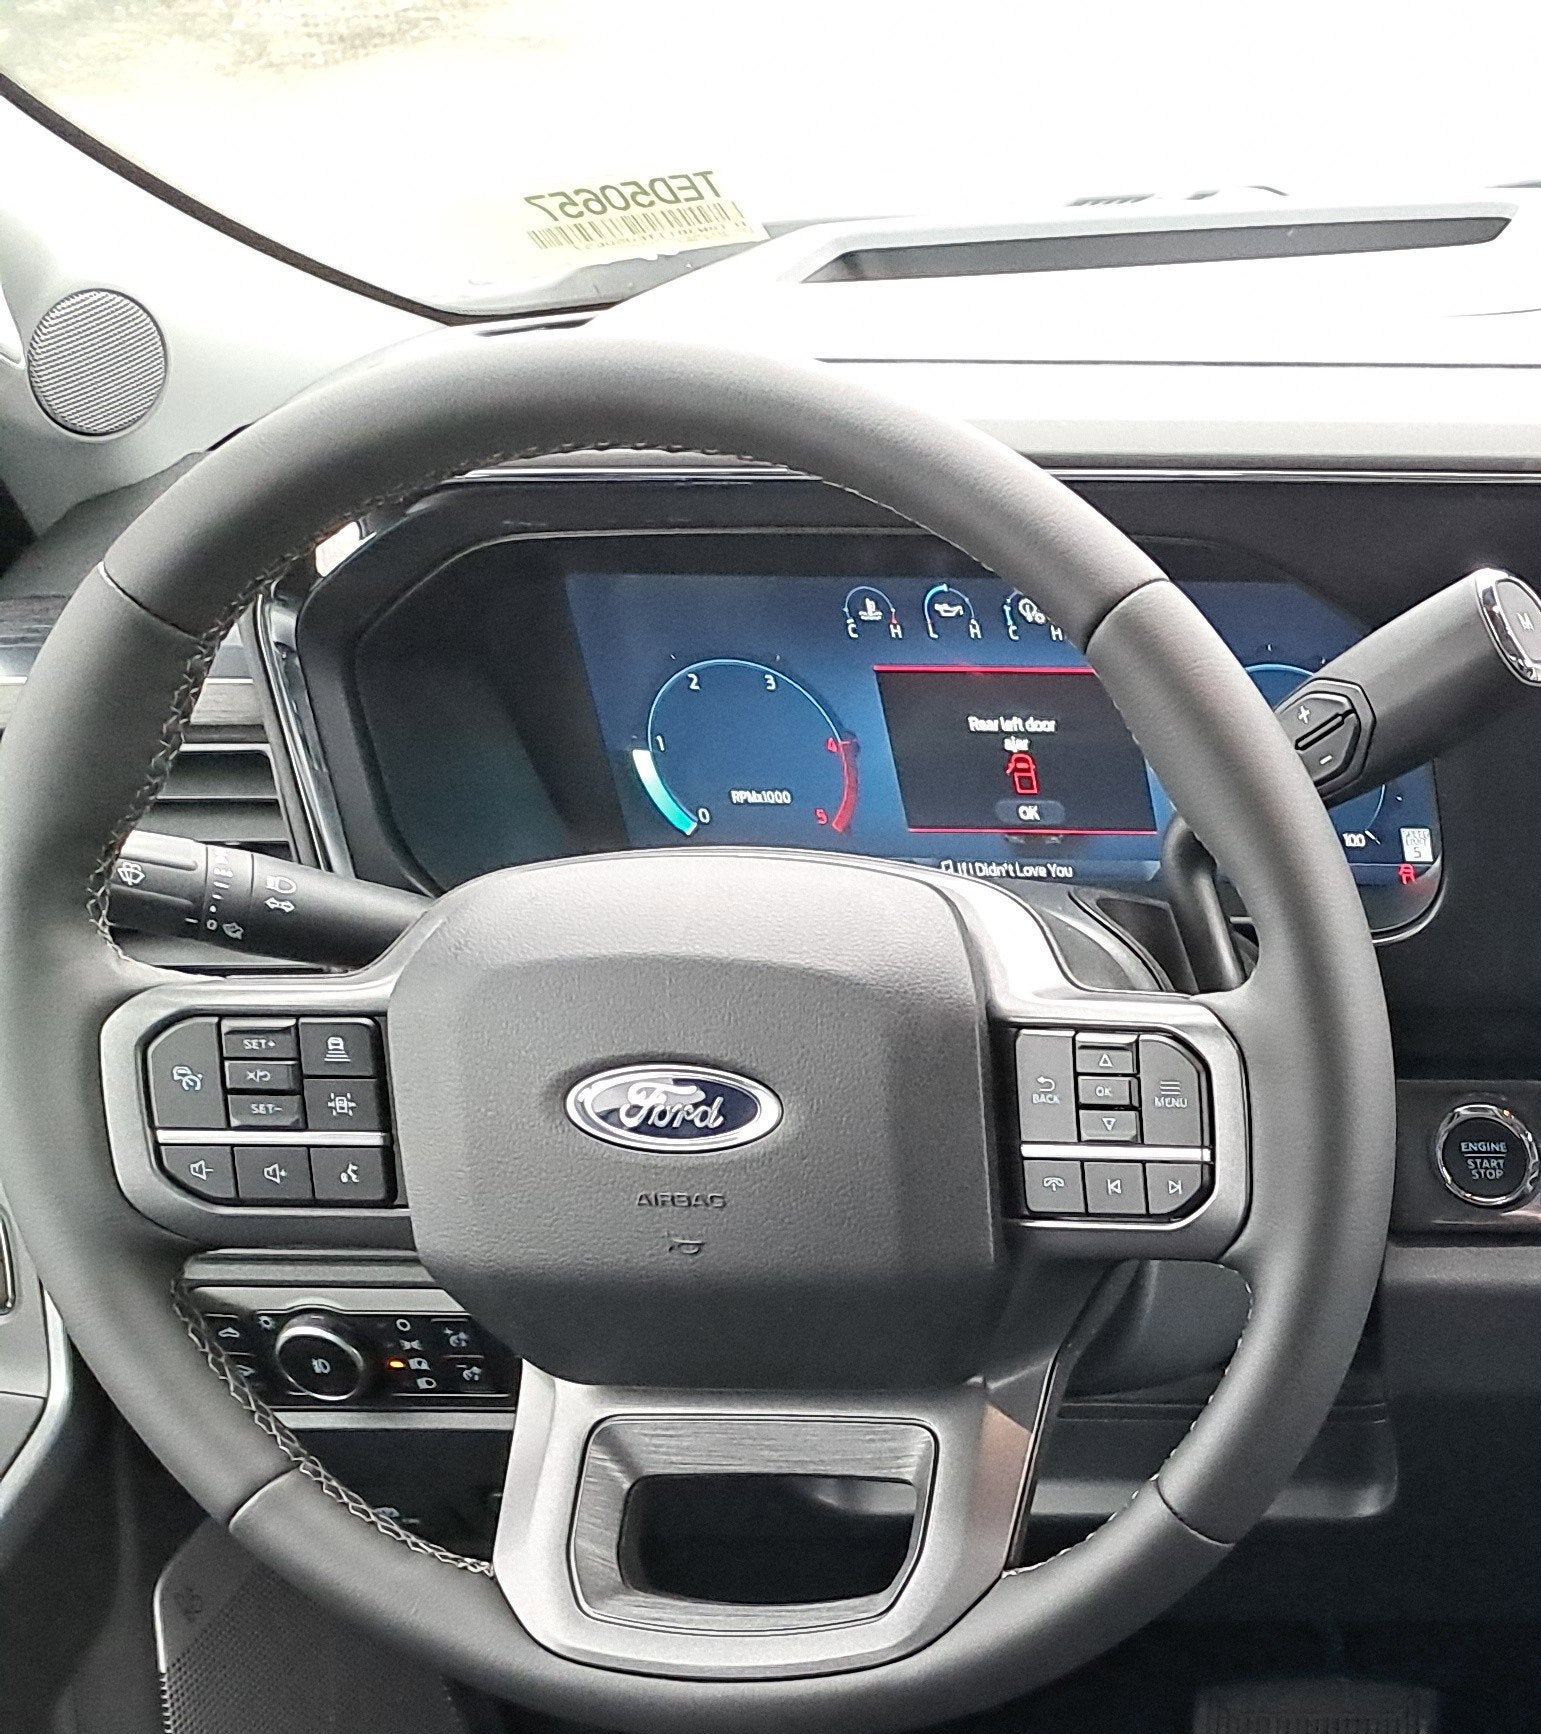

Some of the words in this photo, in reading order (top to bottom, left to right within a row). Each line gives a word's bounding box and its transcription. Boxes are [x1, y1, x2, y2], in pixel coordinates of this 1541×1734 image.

[687, 673, 700, 690] 2
[764, 674, 776, 690] 3
[656, 735, 666, 751] 1
[698, 808, 710, 823] 0
[1018, 805, 1041, 820] OK
[1016, 863, 1046, 878] Love
[1047, 863, 1073, 878] You
[1095, 1086, 1113, 1097] OK
[619, 1081, 724, 1129] Ford
[1032, 1094, 1061, 1105] BACK
[1154, 1096, 1187, 1108] MENU
[1460, 1142, 1507, 1153] ENGINE
[1467, 1159, 1505, 1169] START
[1471, 1169, 1504, 1180] STOP
[637, 1192, 728, 1209] AIRBAG
